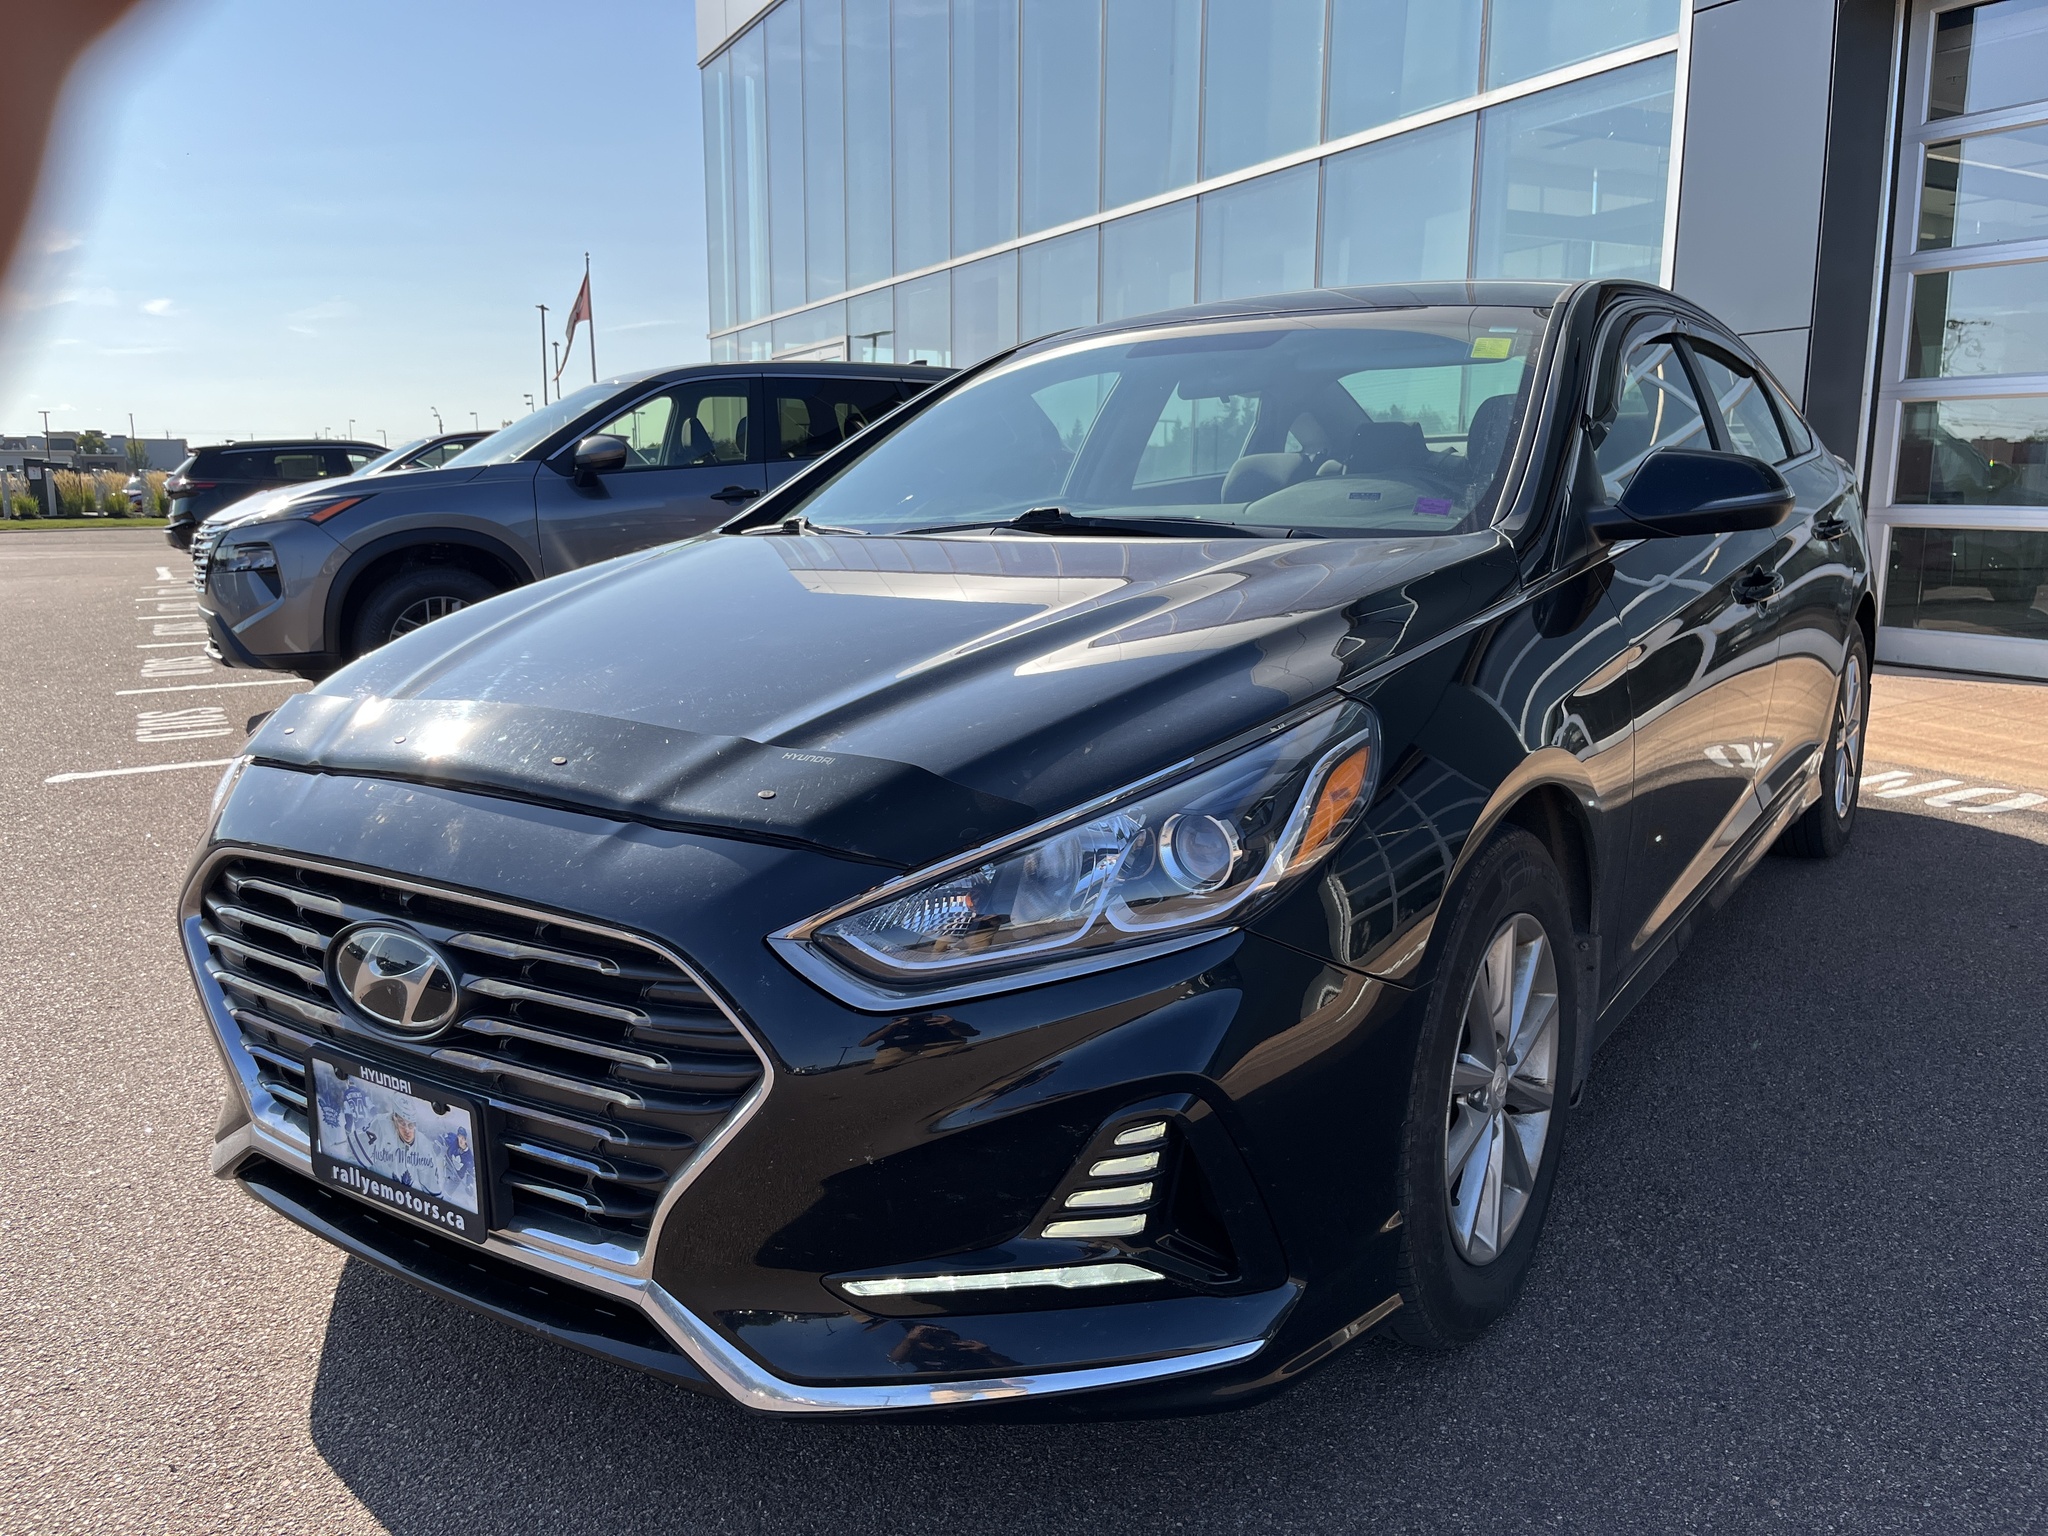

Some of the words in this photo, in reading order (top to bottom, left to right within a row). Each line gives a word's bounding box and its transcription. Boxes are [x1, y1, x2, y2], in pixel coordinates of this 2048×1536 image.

[781, 752, 837, 766] HYUNDAI
[360, 1066, 412, 1095] HYUNDAI
[395, 1146, 434, 1168] Matthews
[331, 1165, 466, 1231] rallyemotors.ca
